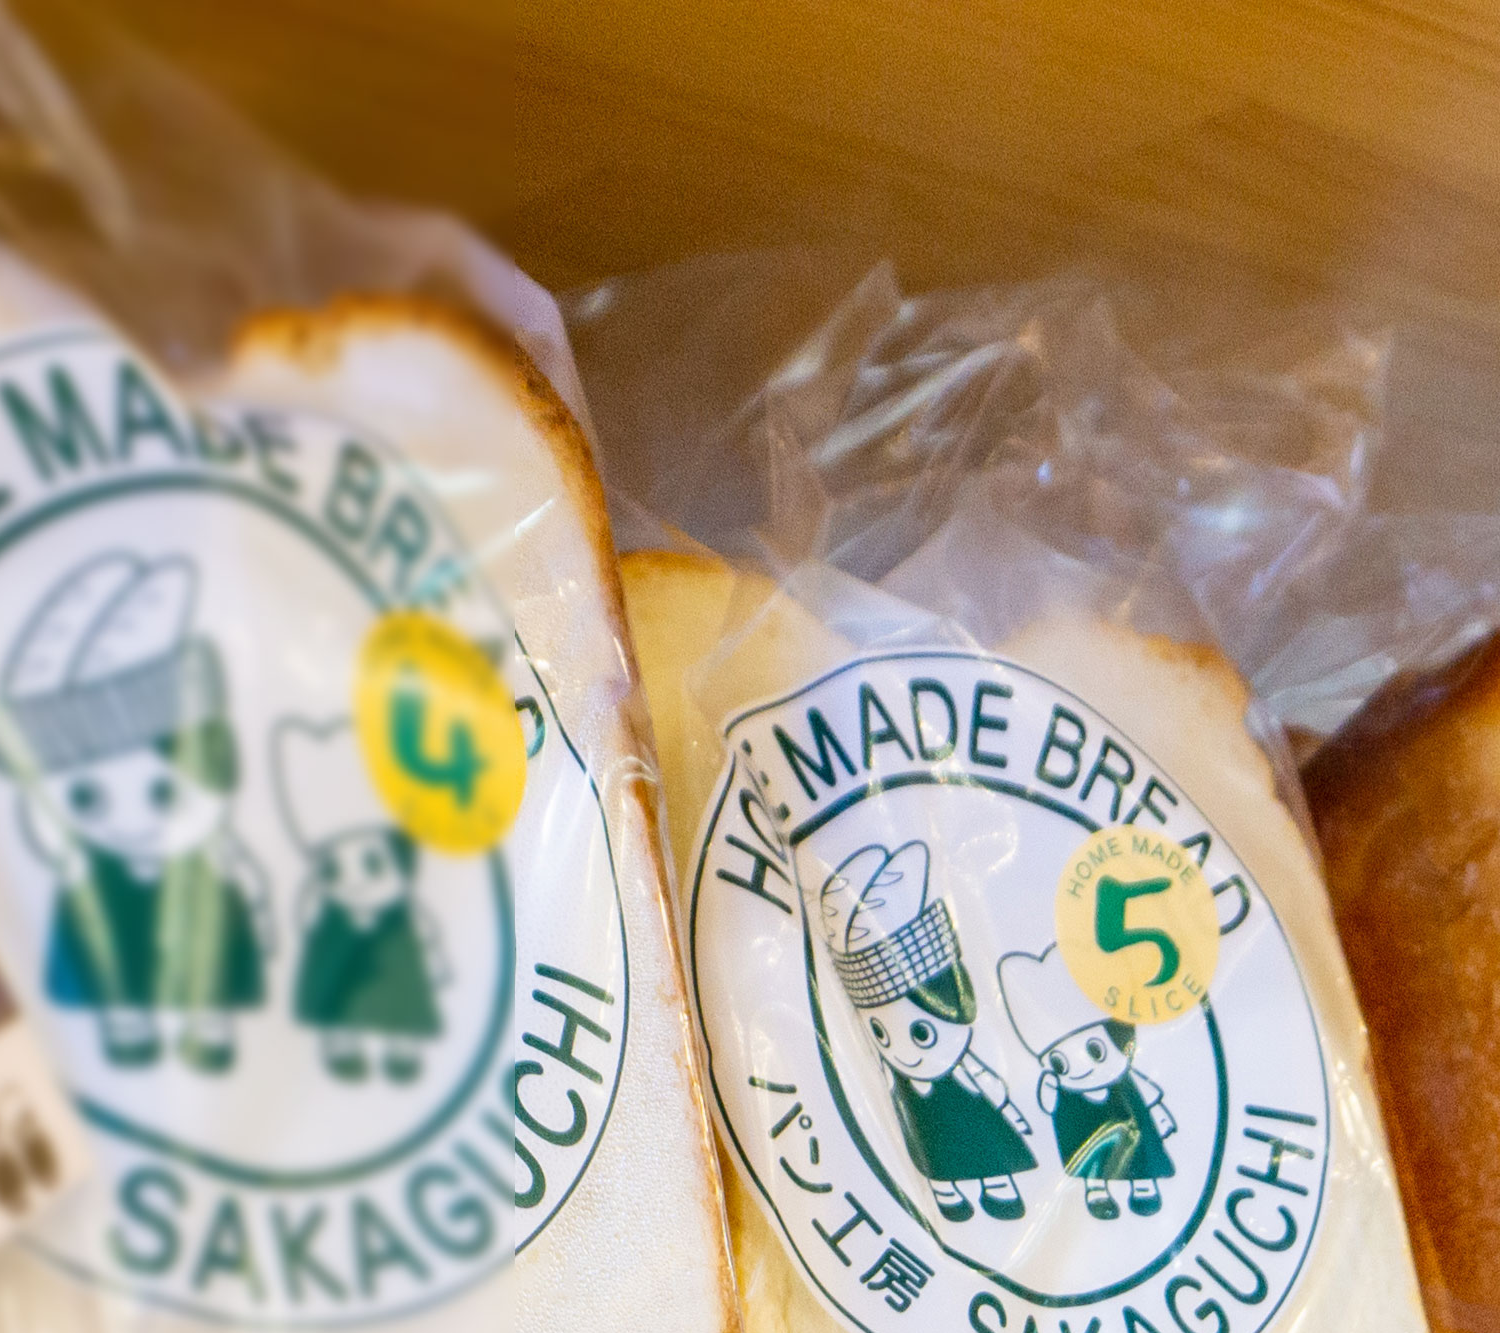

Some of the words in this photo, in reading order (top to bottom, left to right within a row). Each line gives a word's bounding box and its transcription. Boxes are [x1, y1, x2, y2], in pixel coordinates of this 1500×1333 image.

[771, 676, 1014, 802] MADE
[1065, 835, 1124, 899] HOME
[1130, 834, 1198, 886] MADE
[1094, 874, 1180, 988] 5
[1102, 972, 1203, 1019] SLICE
[106, 961, 616, 1303] SAKAGUCHI
[748, 1075, 936, 1314] パン工房
